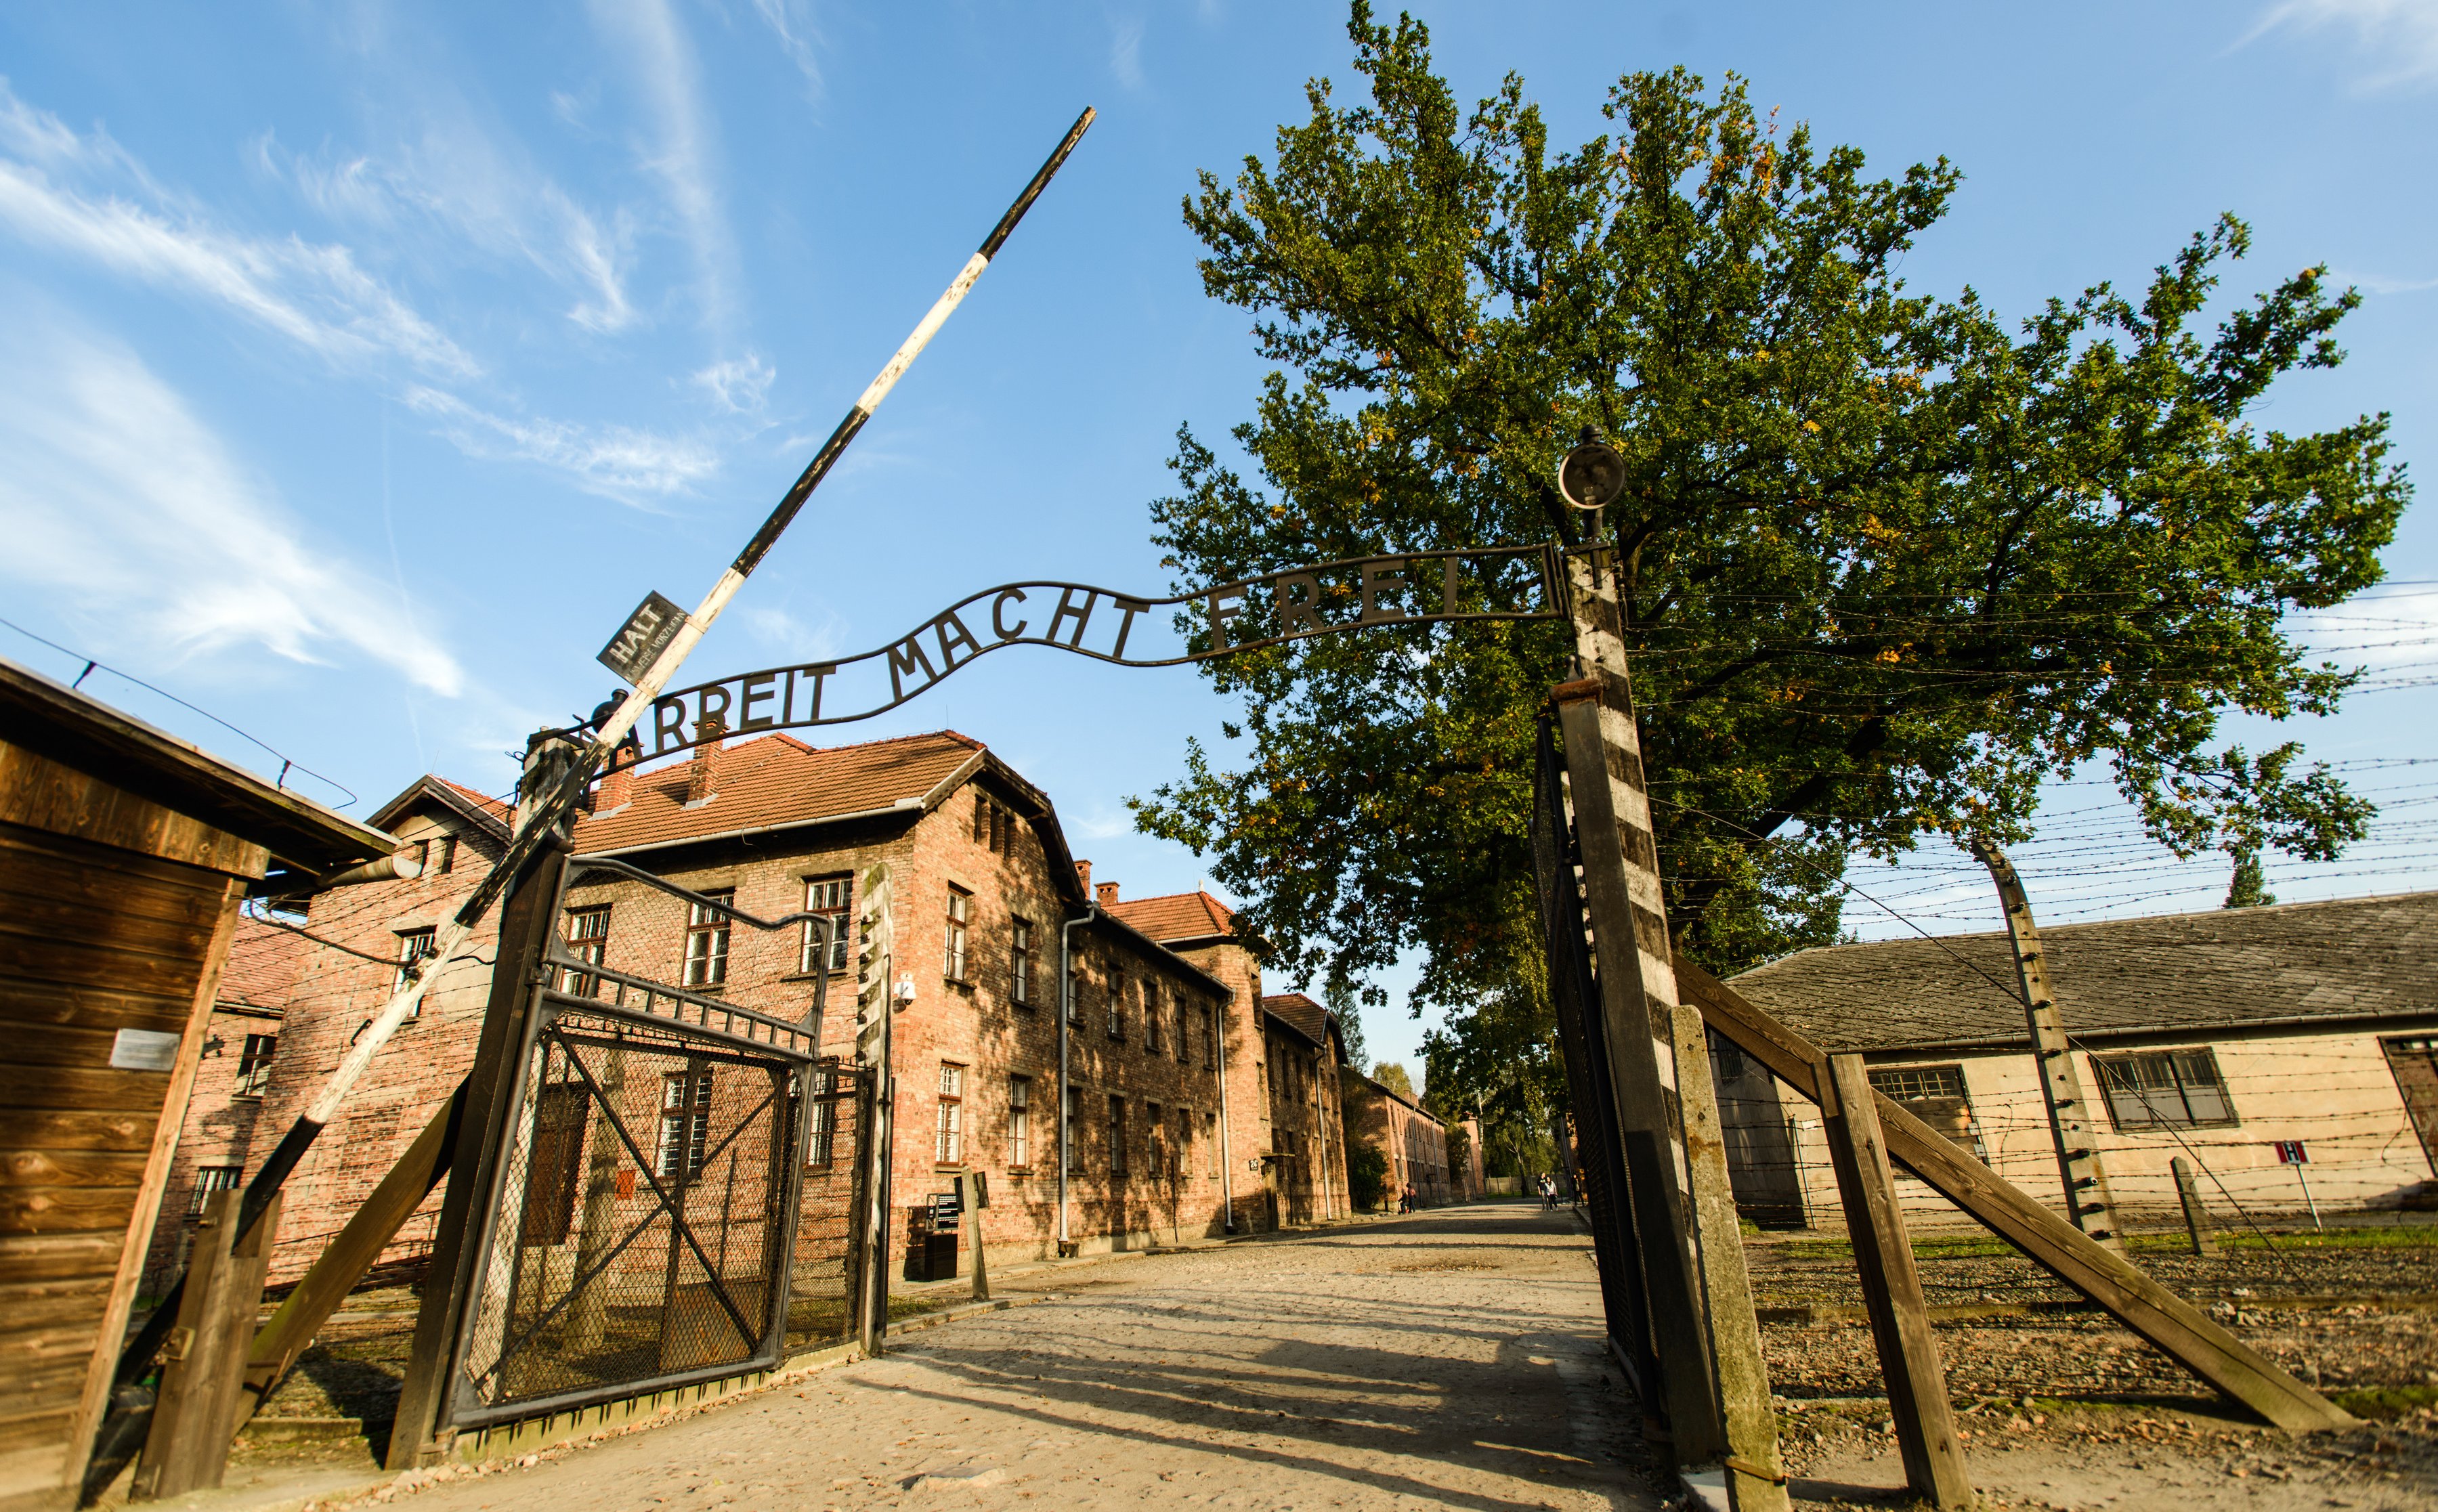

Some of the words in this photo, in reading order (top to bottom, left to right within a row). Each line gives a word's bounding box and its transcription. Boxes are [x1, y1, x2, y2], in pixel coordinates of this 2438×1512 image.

[608, 665, 836, 769] ARBEIT
[886, 587, 1151, 704] MACHT
[1208, 555, 1458, 651] FREI
[609, 603, 662, 664] HALT
[2283, 1142, 2300, 1161] H
